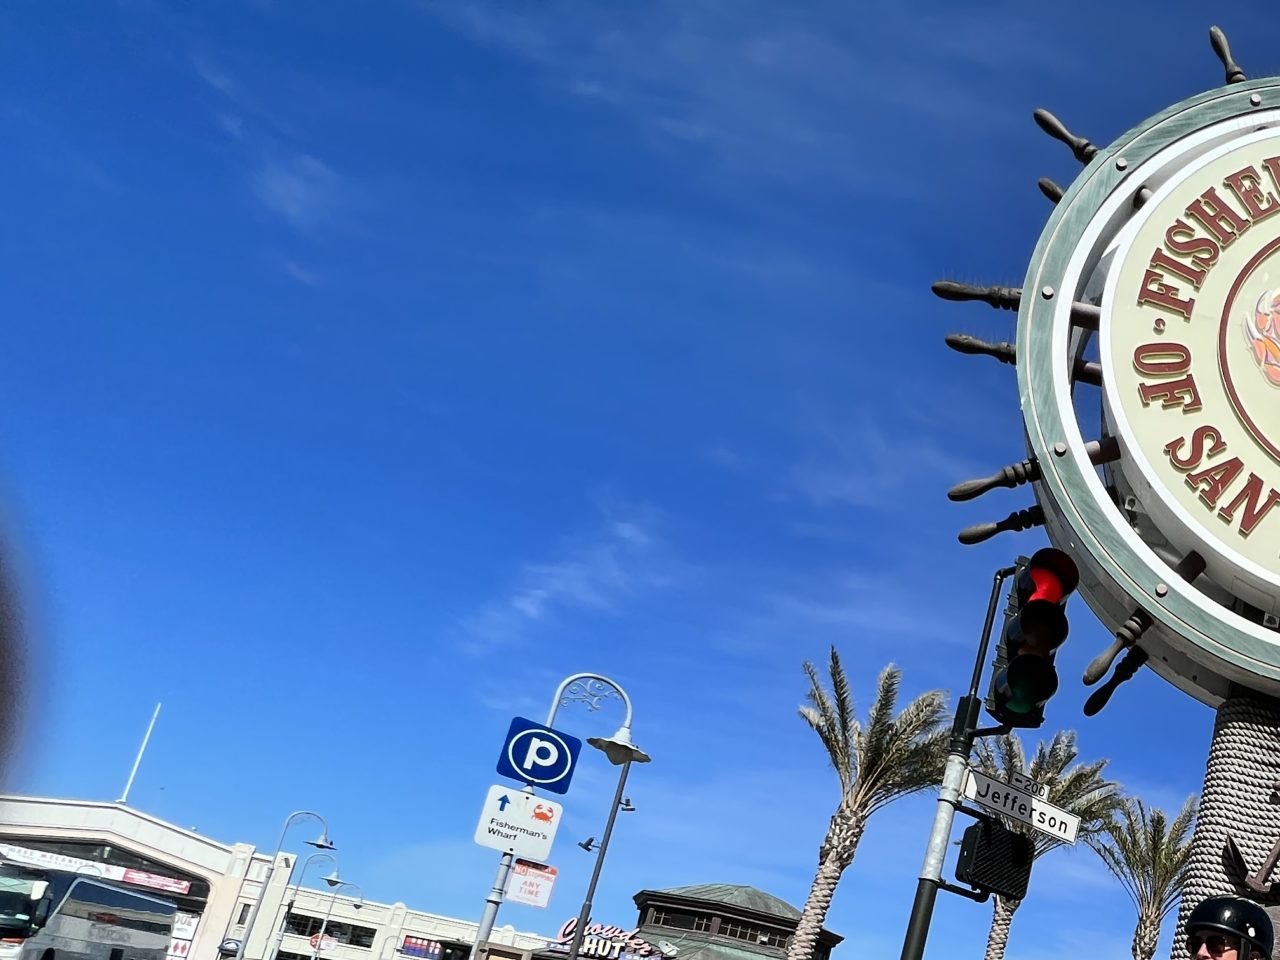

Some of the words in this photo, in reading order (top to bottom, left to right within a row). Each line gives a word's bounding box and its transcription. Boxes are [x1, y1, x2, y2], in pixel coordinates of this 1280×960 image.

[1133, 341, 1202, 413] OF
[522, 736, 559, 770] P
[1024, 779, 1046, 798] 200
[976, 783, 1068, 834] Jefferson
[487, 827, 519, 842] Wharf
[489, 817, 548, 841] Fisherman's
[514, 864, 527, 875] NO
[519, 886, 540, 898] TIME
[522, 880, 541, 889] ANY
[583, 936, 626, 959] HUT
